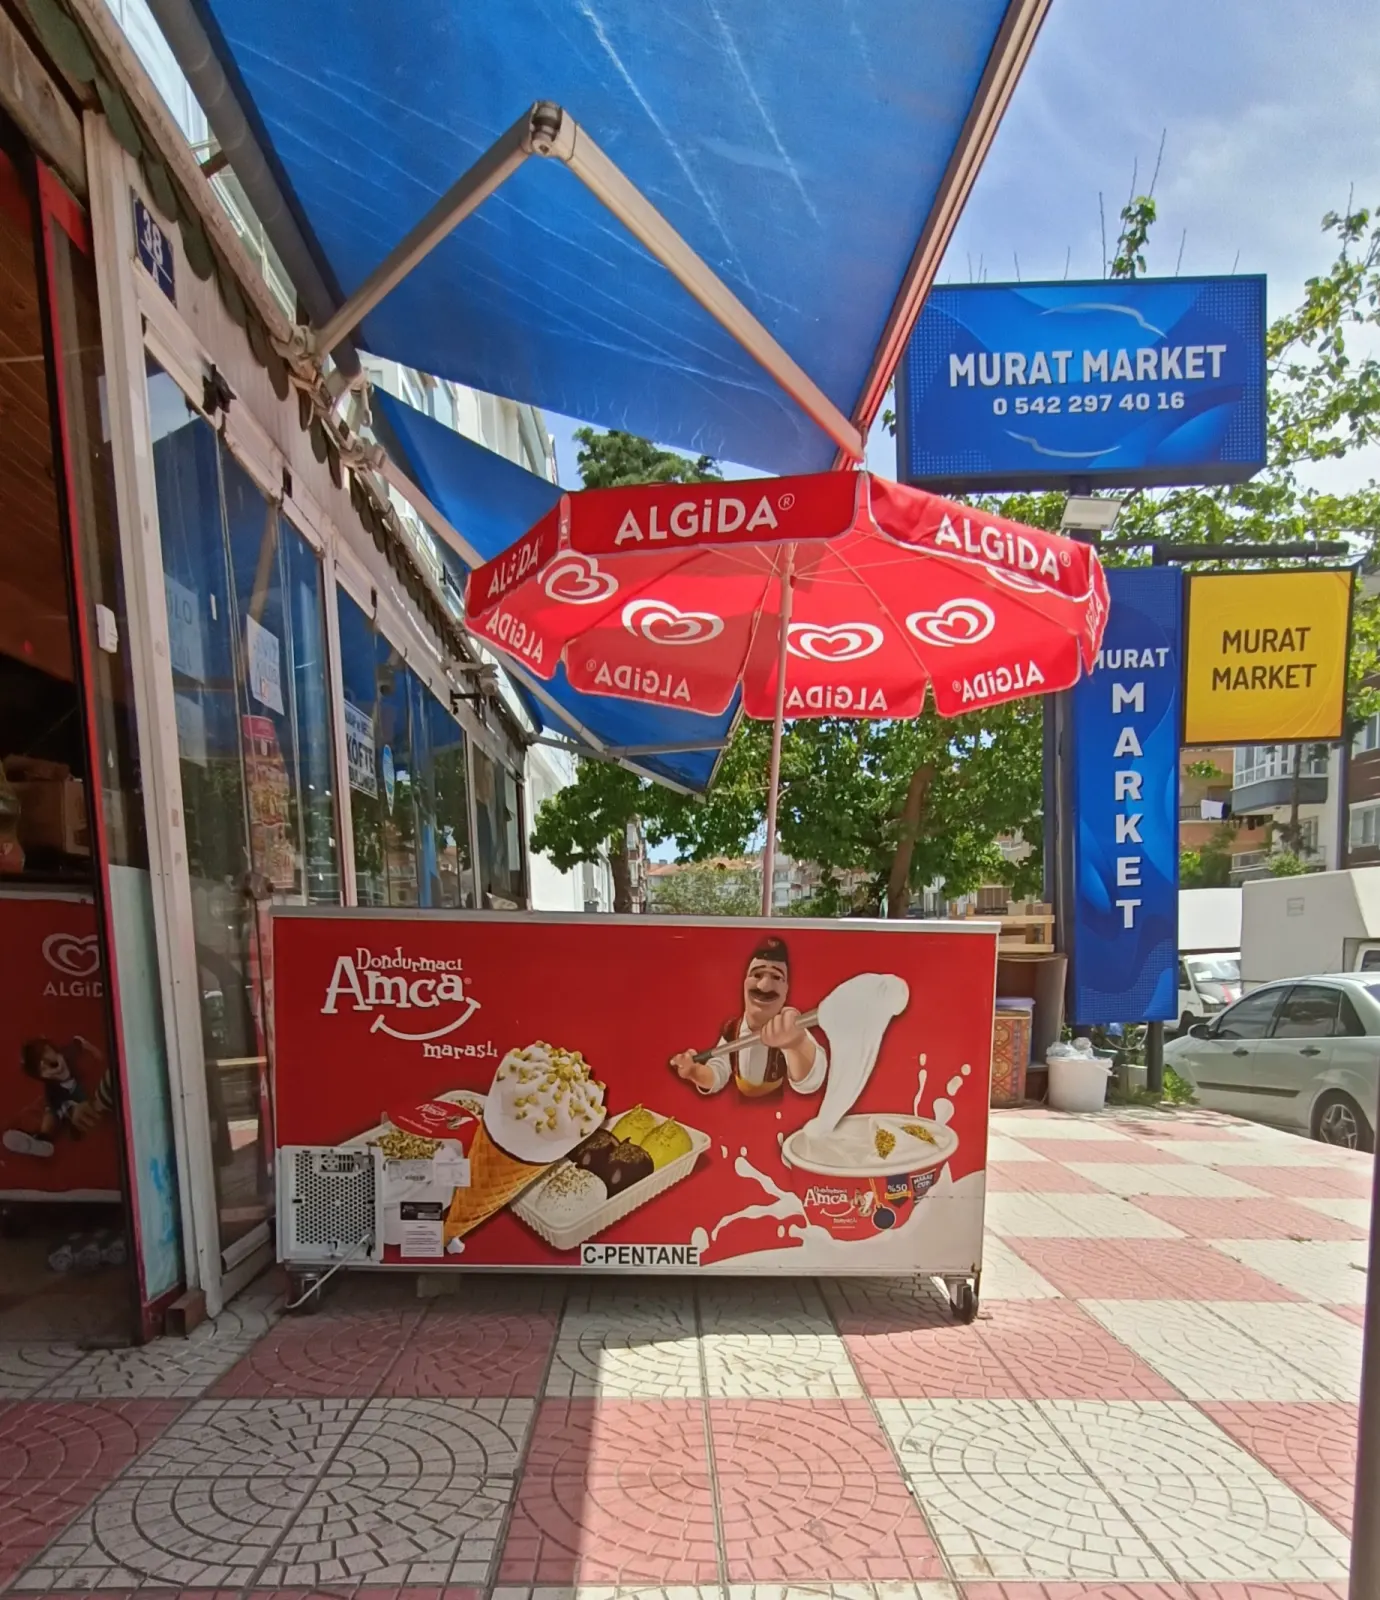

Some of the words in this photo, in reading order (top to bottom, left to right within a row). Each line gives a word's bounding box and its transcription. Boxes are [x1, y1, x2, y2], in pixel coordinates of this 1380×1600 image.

[949, 350, 1074, 387] MURAT
[1082, 344, 1227, 381] MARKET
[992, 398, 1008, 416] 0
[1015, 396, 1062, 415] 542
[1068, 394, 1113, 413] 297
[1119, 392, 1151, 411] 40
[1156, 391, 1185, 410] 16
[1221, 626, 1311, 655] MURAT
[1212, 663, 1317, 692] MARKET
[1111, 682, 1146, 930] MARKET
[803, 1188, 848, 1208] Amca
[583, 1246, 698, 1265] C-PENTANE
